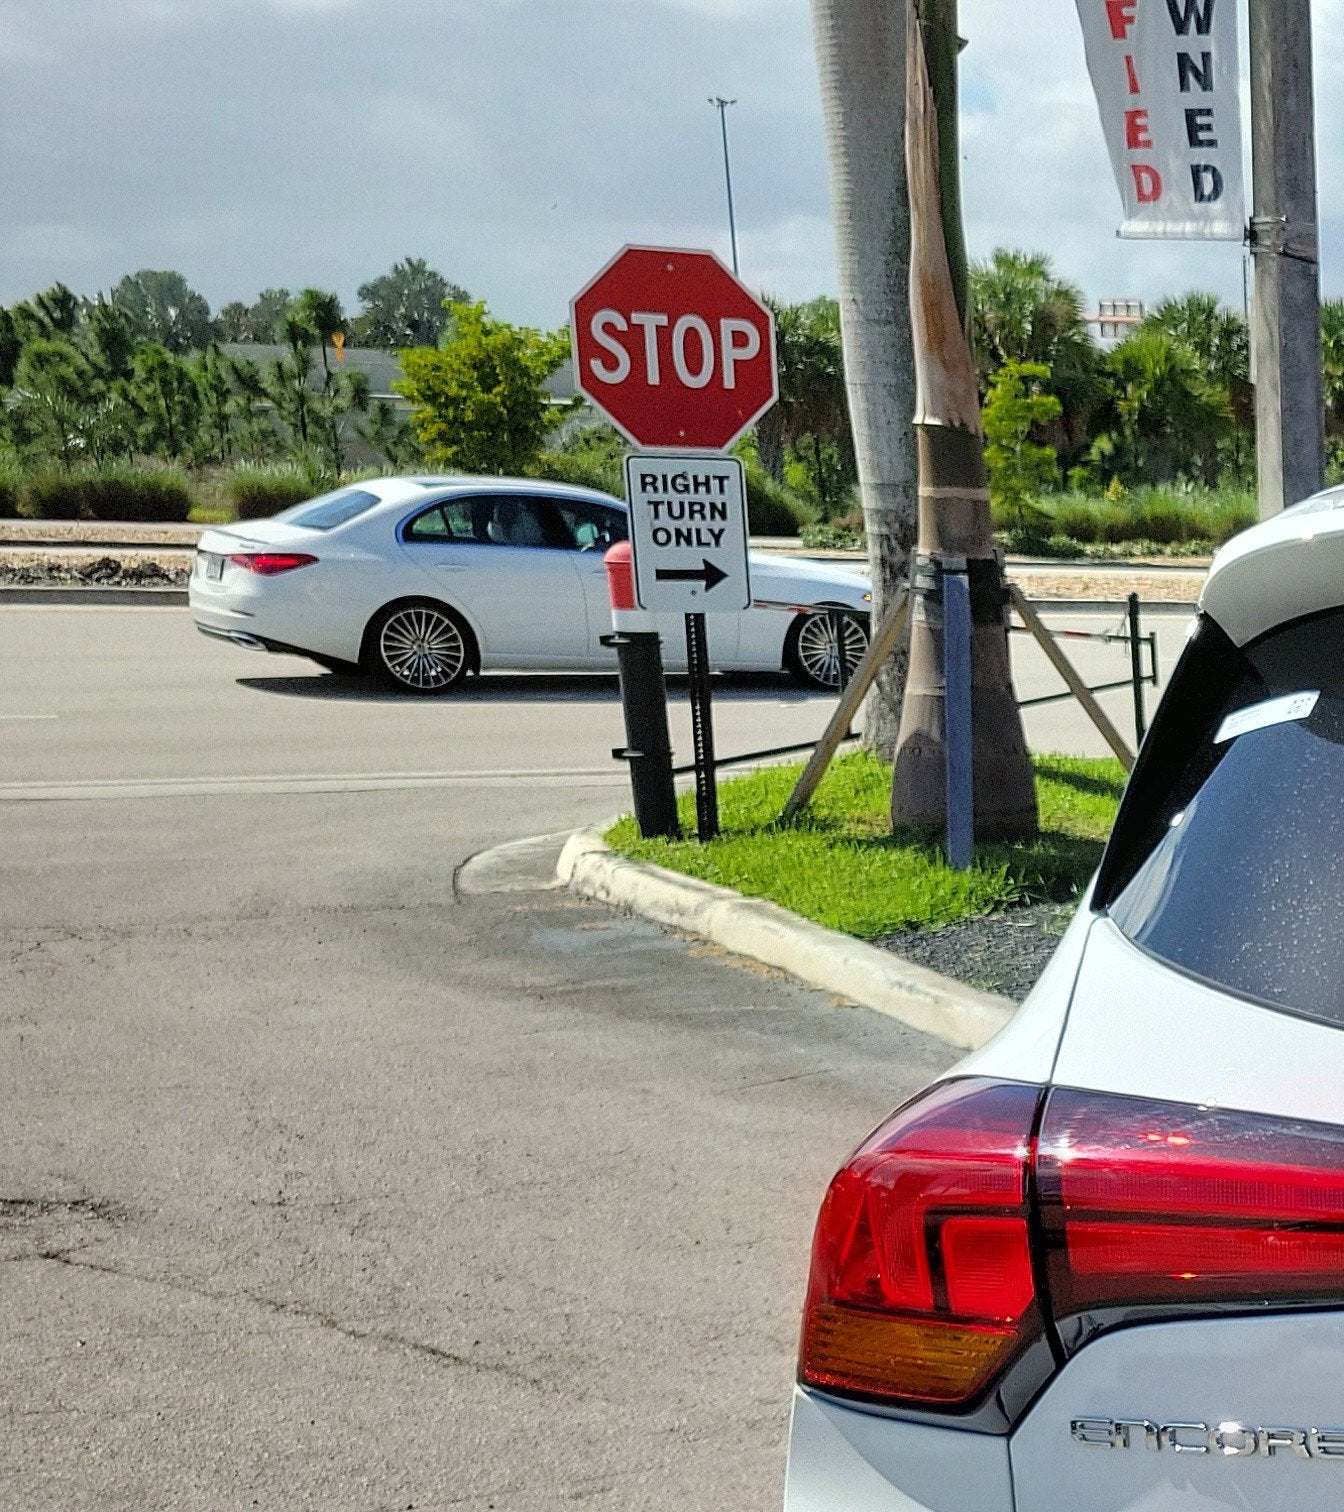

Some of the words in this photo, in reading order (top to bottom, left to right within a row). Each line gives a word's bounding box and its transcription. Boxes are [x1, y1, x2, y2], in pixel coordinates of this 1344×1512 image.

[590, 309, 761, 390] STOP
[640, 472, 730, 496] RIGHT
[647, 500, 728, 522] TURN
[651, 528, 727, 548] ONLY
